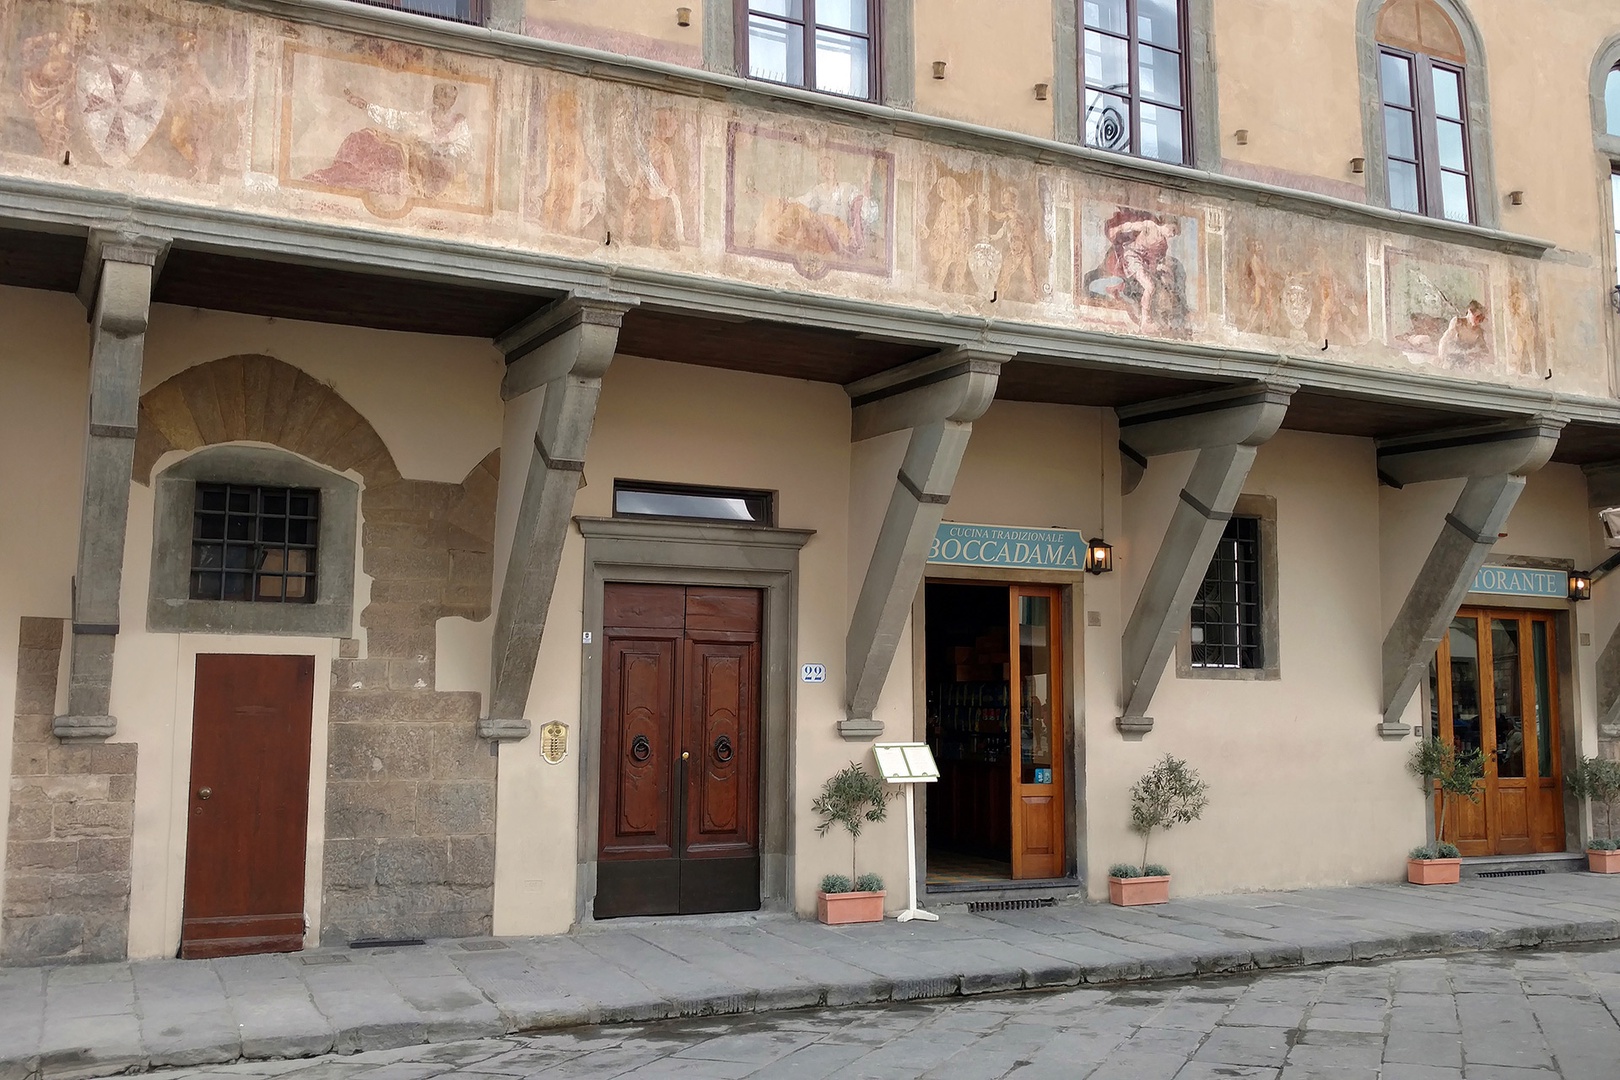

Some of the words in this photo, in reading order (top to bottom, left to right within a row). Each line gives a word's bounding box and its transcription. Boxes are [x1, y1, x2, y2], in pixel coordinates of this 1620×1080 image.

[949, 527, 989, 539] CUCINA
[991, 530, 1065, 543] TRADIZIONALE
[928, 538, 1079, 566] BOCCADAMA
[804, 665, 822, 680] 22
